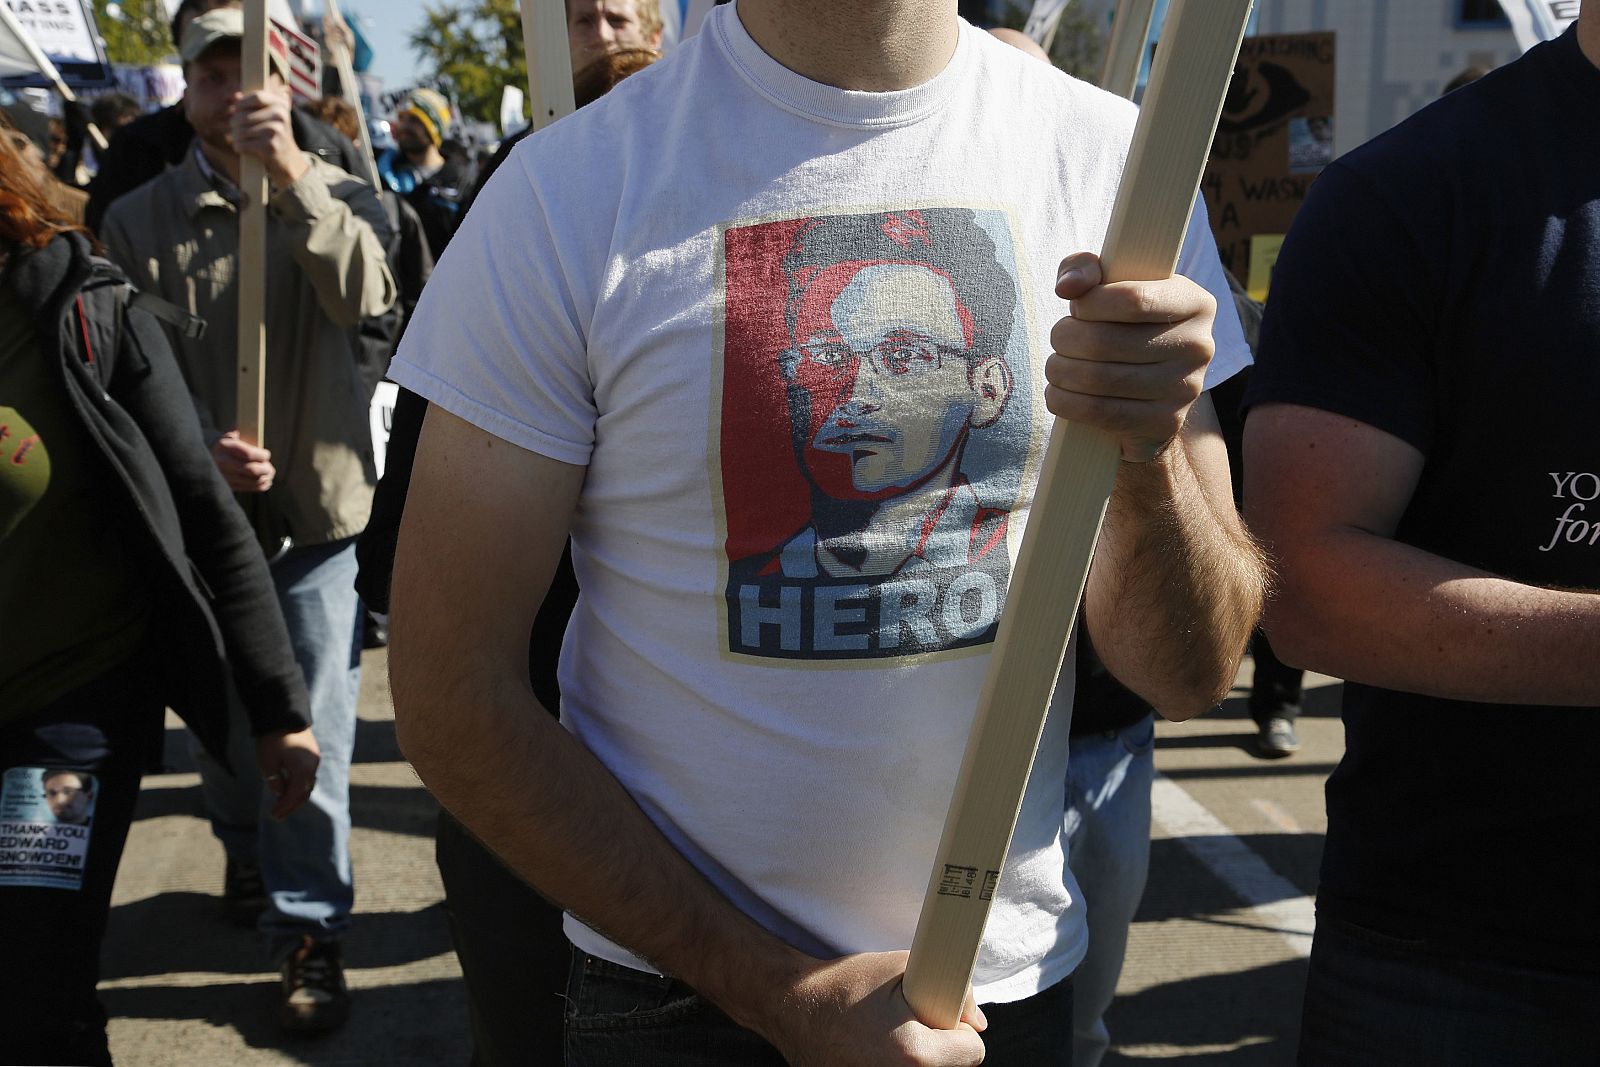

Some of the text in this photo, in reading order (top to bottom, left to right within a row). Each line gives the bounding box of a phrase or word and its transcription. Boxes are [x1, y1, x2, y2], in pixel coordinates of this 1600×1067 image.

[1548, 471, 1600, 501] YO
[738, 571, 998, 651] HERO
[1, 823, 49, 836] THANK
[0, 836, 69, 852] EDWARD
